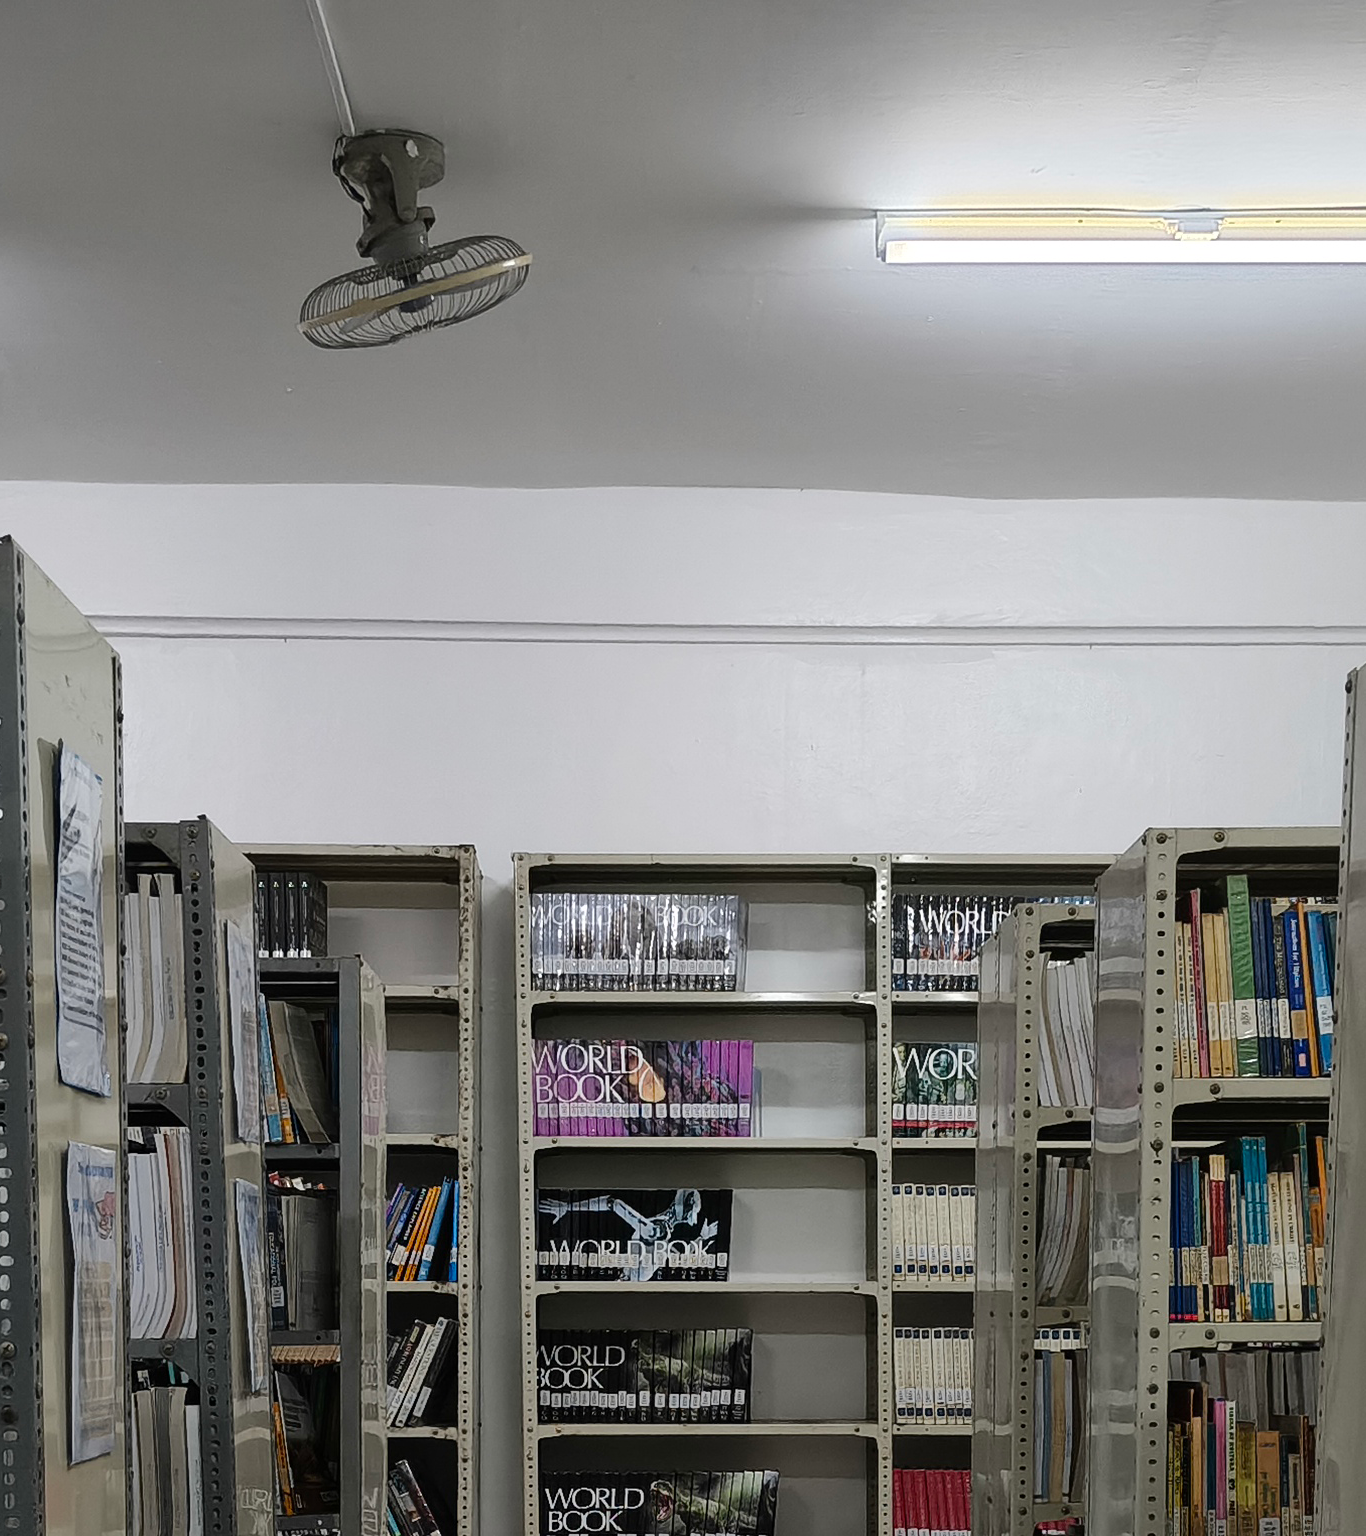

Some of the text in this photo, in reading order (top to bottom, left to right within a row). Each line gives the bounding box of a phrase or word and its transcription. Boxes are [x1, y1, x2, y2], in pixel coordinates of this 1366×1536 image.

[654, 906, 718, 927] BOOK
[532, 1044, 643, 1074] WORLD
[536, 1075, 625, 1103] BOOK
[549, 1240, 715, 1262] WORLD BOOK
[537, 1345, 625, 1367] WORLD
[537, 1368, 604, 1389] BOOK
[545, 1488, 645, 1509] WORLD
[548, 1511, 623, 1532] BOOK
